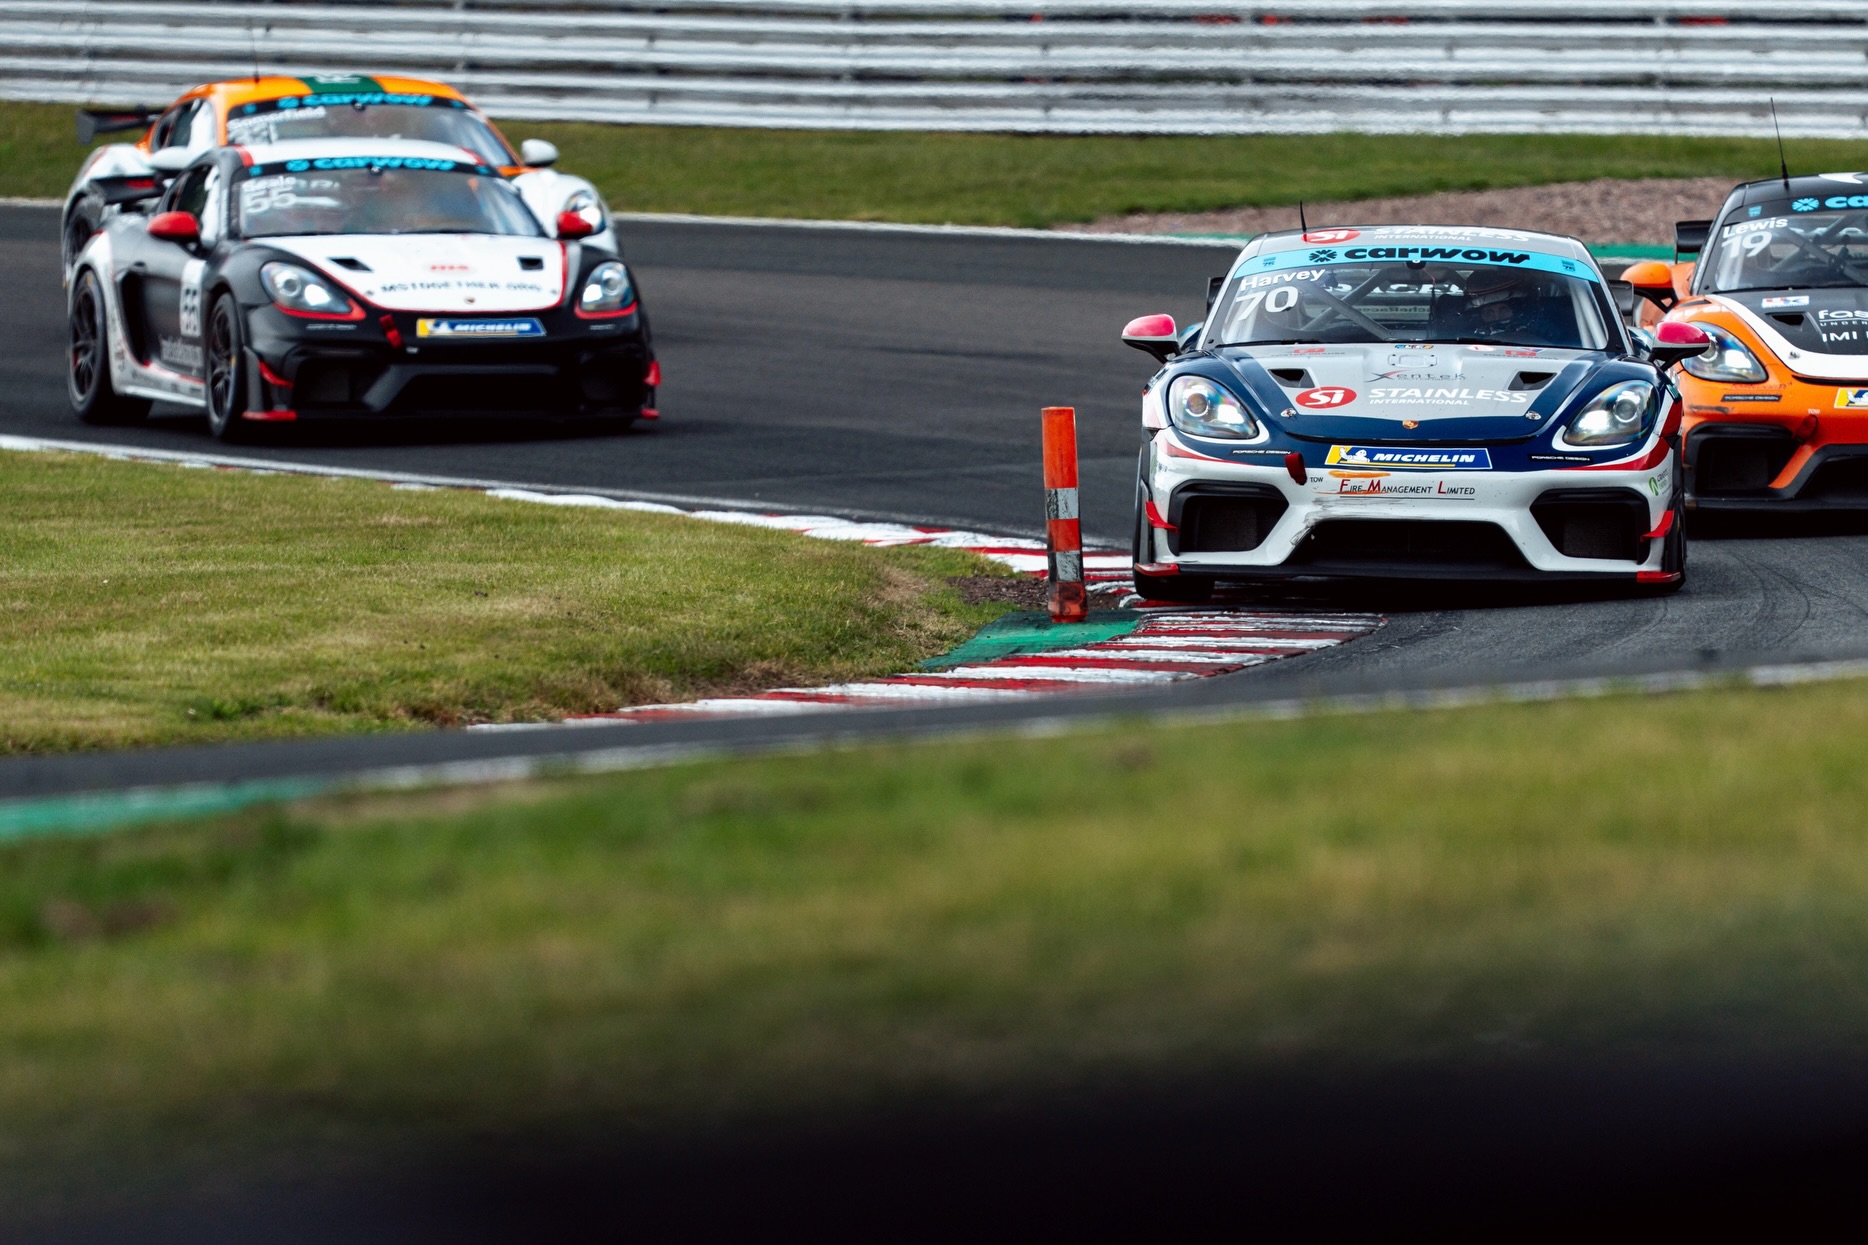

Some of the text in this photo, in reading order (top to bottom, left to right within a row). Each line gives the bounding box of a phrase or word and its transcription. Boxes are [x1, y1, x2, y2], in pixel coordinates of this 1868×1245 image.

[313, 157, 455, 170] carwow
[246, 186, 296, 213] 55
[1723, 217, 1788, 239] Lewis
[1374, 234, 1472, 242] INTERNATIONAL
[1721, 231, 1772, 257] 19
[1344, 247, 1530, 264] carwow
[1240, 269, 1326, 292] Harvey
[1236, 286, 1299, 321] 70
[454, 322, 533, 332] MICHELIN
[1822, 331, 1858, 342] IMI
[1368, 388, 1528, 403] STAINLESS
[1373, 453, 1475, 463] MICHELIN
[1339, 479, 1475, 495] FIRE MANAGEMENT LIMITED
